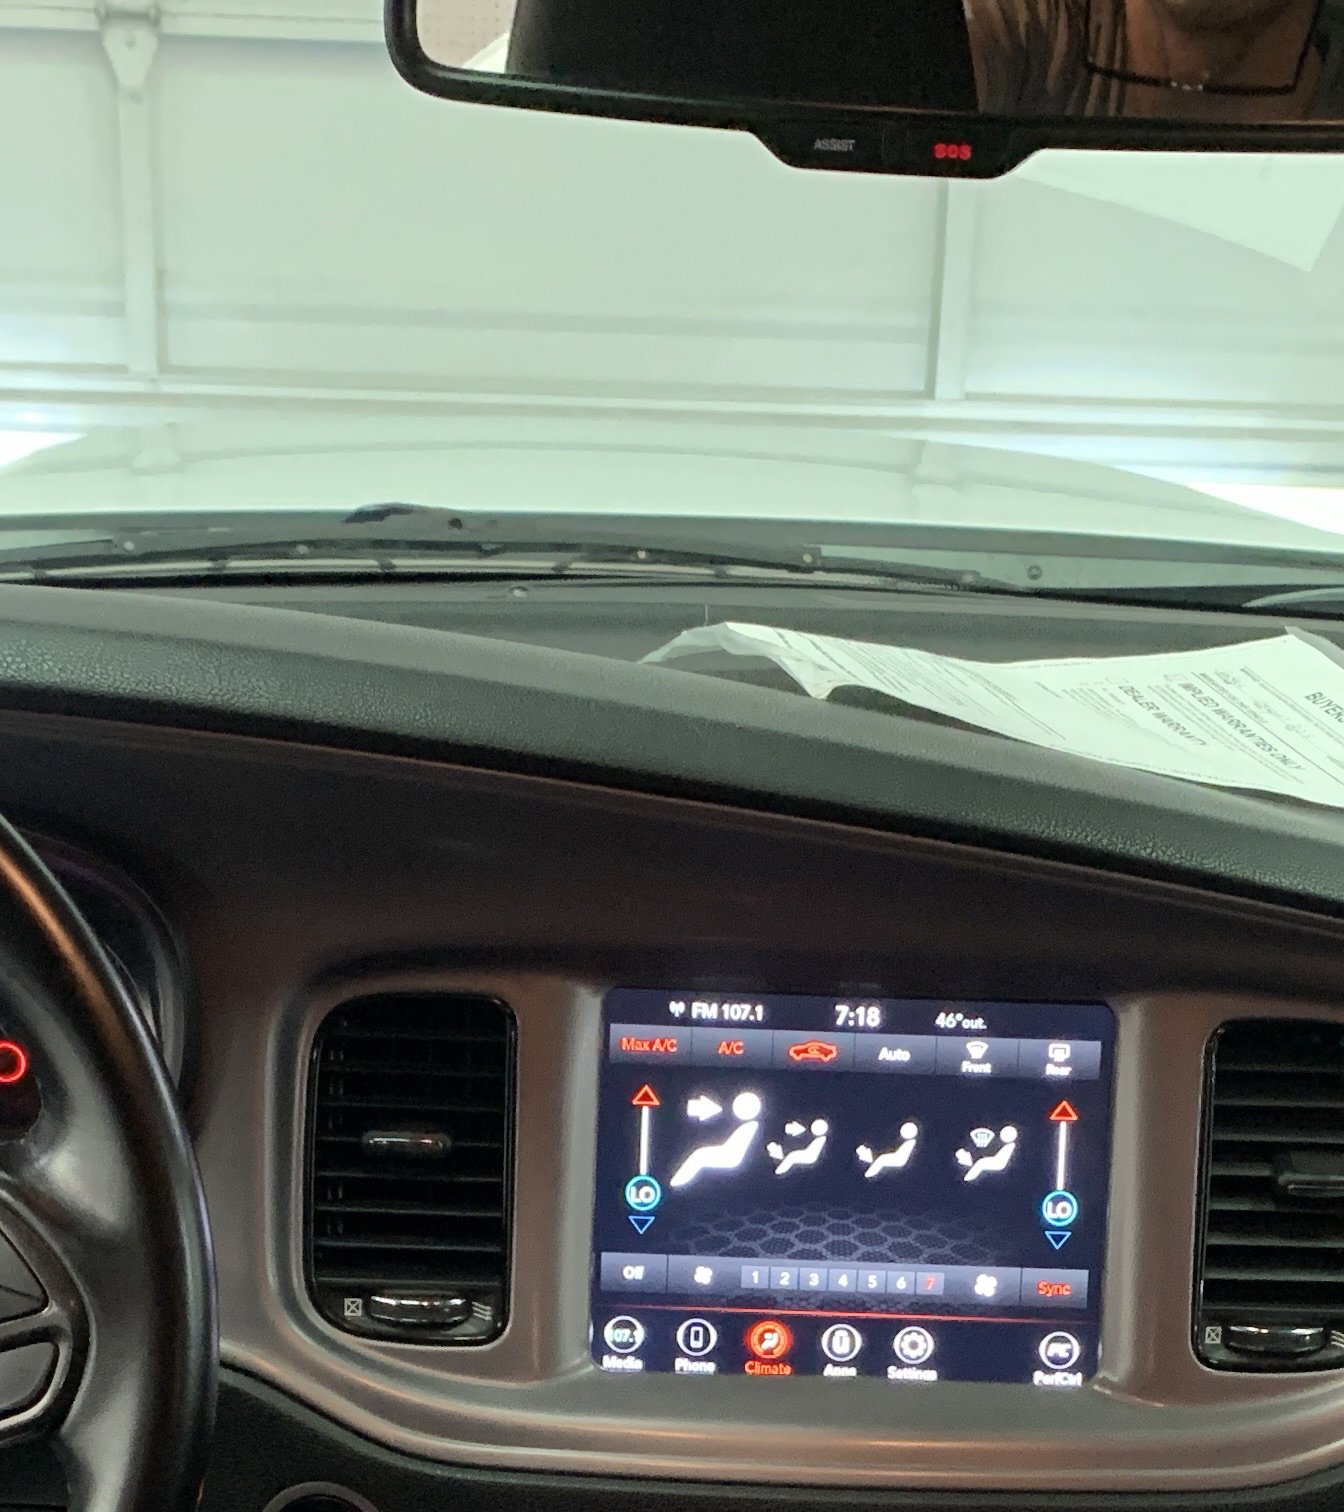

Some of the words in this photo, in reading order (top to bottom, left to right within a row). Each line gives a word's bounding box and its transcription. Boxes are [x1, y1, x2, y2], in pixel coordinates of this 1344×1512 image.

[813, 138, 856, 151] ASSIST
[933, 143, 972, 160] SOS
[1117, 684, 1162, 712] DEALER
[691, 1002, 718, 1020] FM
[722, 1003, 764, 1022] 107.1
[835, 1004, 881, 1027] 7:18
[621, 1036, 649, 1052] Max
[653, 1038, 678, 1053] A/C
[718, 1041, 744, 1056] A/C
[878, 1047, 911, 1062] Auto
[961, 1061, 992, 1074] Front
[1045, 1064, 1072, 1076] Rear
[630, 1185, 656, 1199] LO
[1047, 1201, 1073, 1219] LO
[622, 1266, 645, 1281] Off
[752, 1270, 759, 1284] 1
[780, 1271, 790, 1286] 2
[809, 1273, 819, 1287] 3
[838, 1274, 848, 1288] 4
[867, 1275, 878, 1289] 5
[896, 1276, 907, 1290] 6
[926, 1276, 936, 1290] 7
[1037, 1281, 1071, 1298] Sync
[602, 1354, 644, 1371] Media
[675, 1357, 716, 1374] Phone
[744, 1360, 792, 1376] Climate
[887, 1365, 938, 1382] Settings
